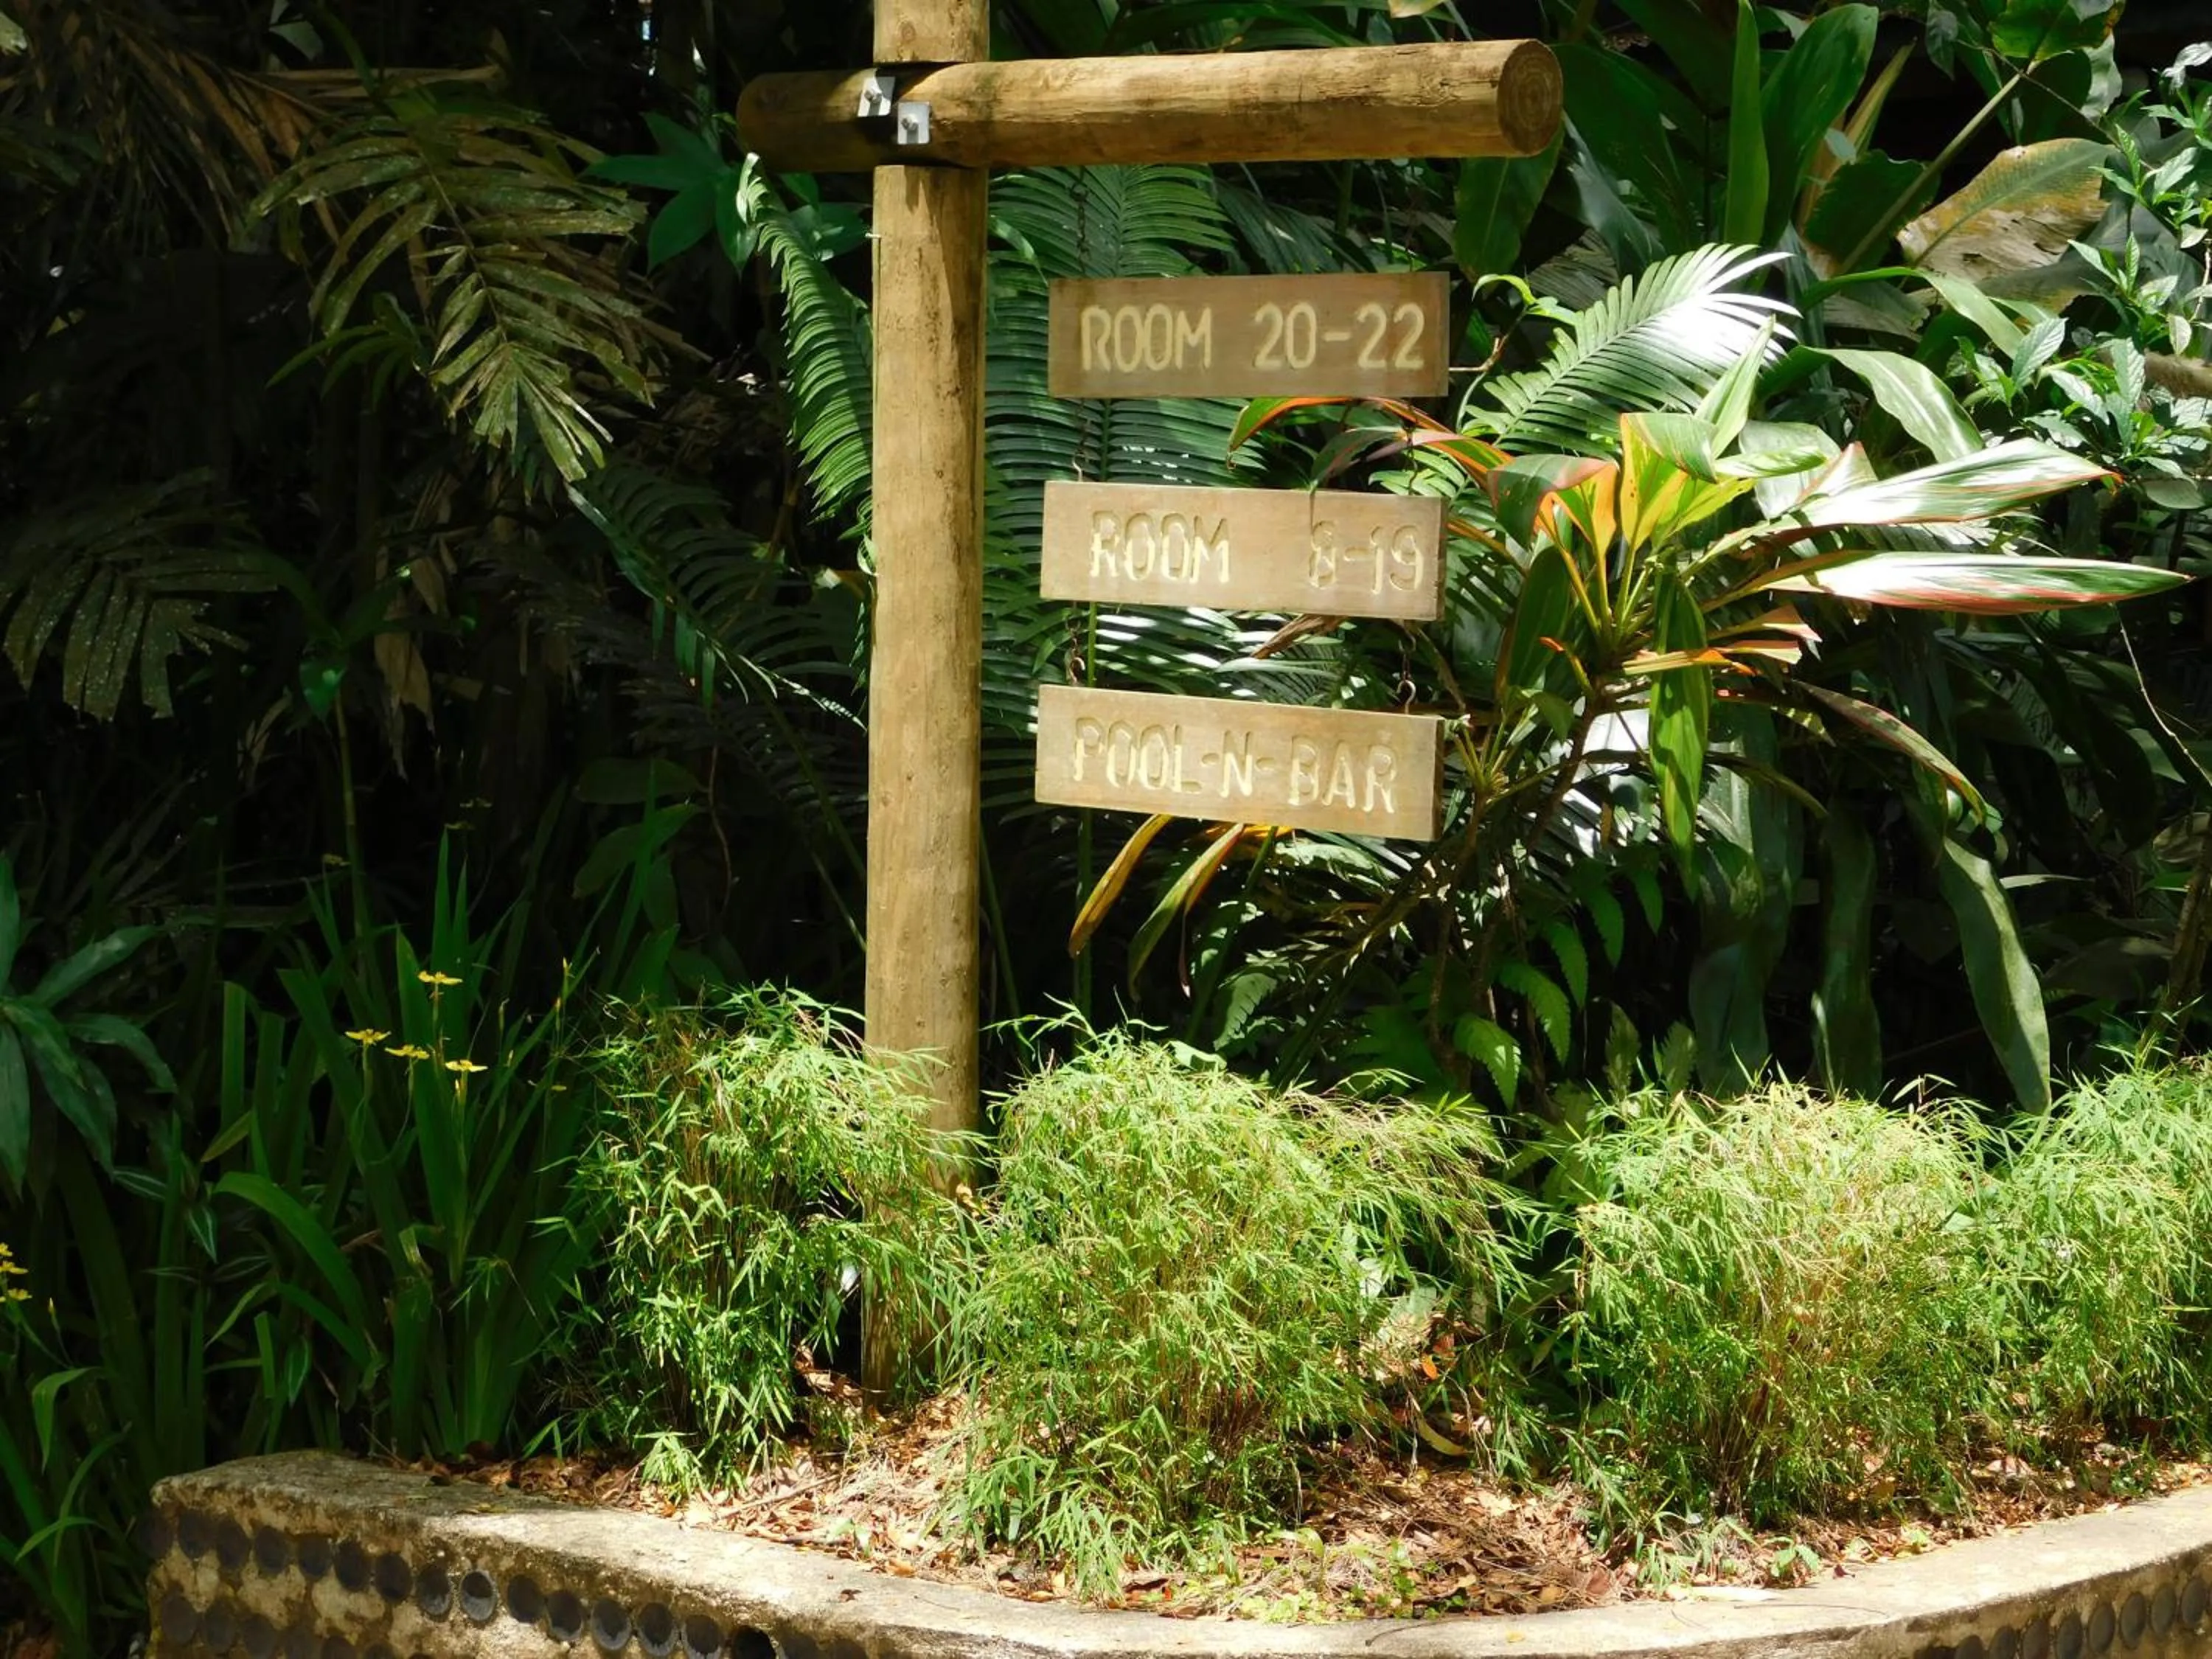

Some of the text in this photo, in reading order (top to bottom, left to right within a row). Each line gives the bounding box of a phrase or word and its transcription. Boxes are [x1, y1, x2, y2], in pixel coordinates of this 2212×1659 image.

[1081, 302, 1425, 372] ROOM 20-22
[1088, 510, 1425, 595] ROOM 8-19
[1072, 717, 1397, 813] POOL-N-BAR
